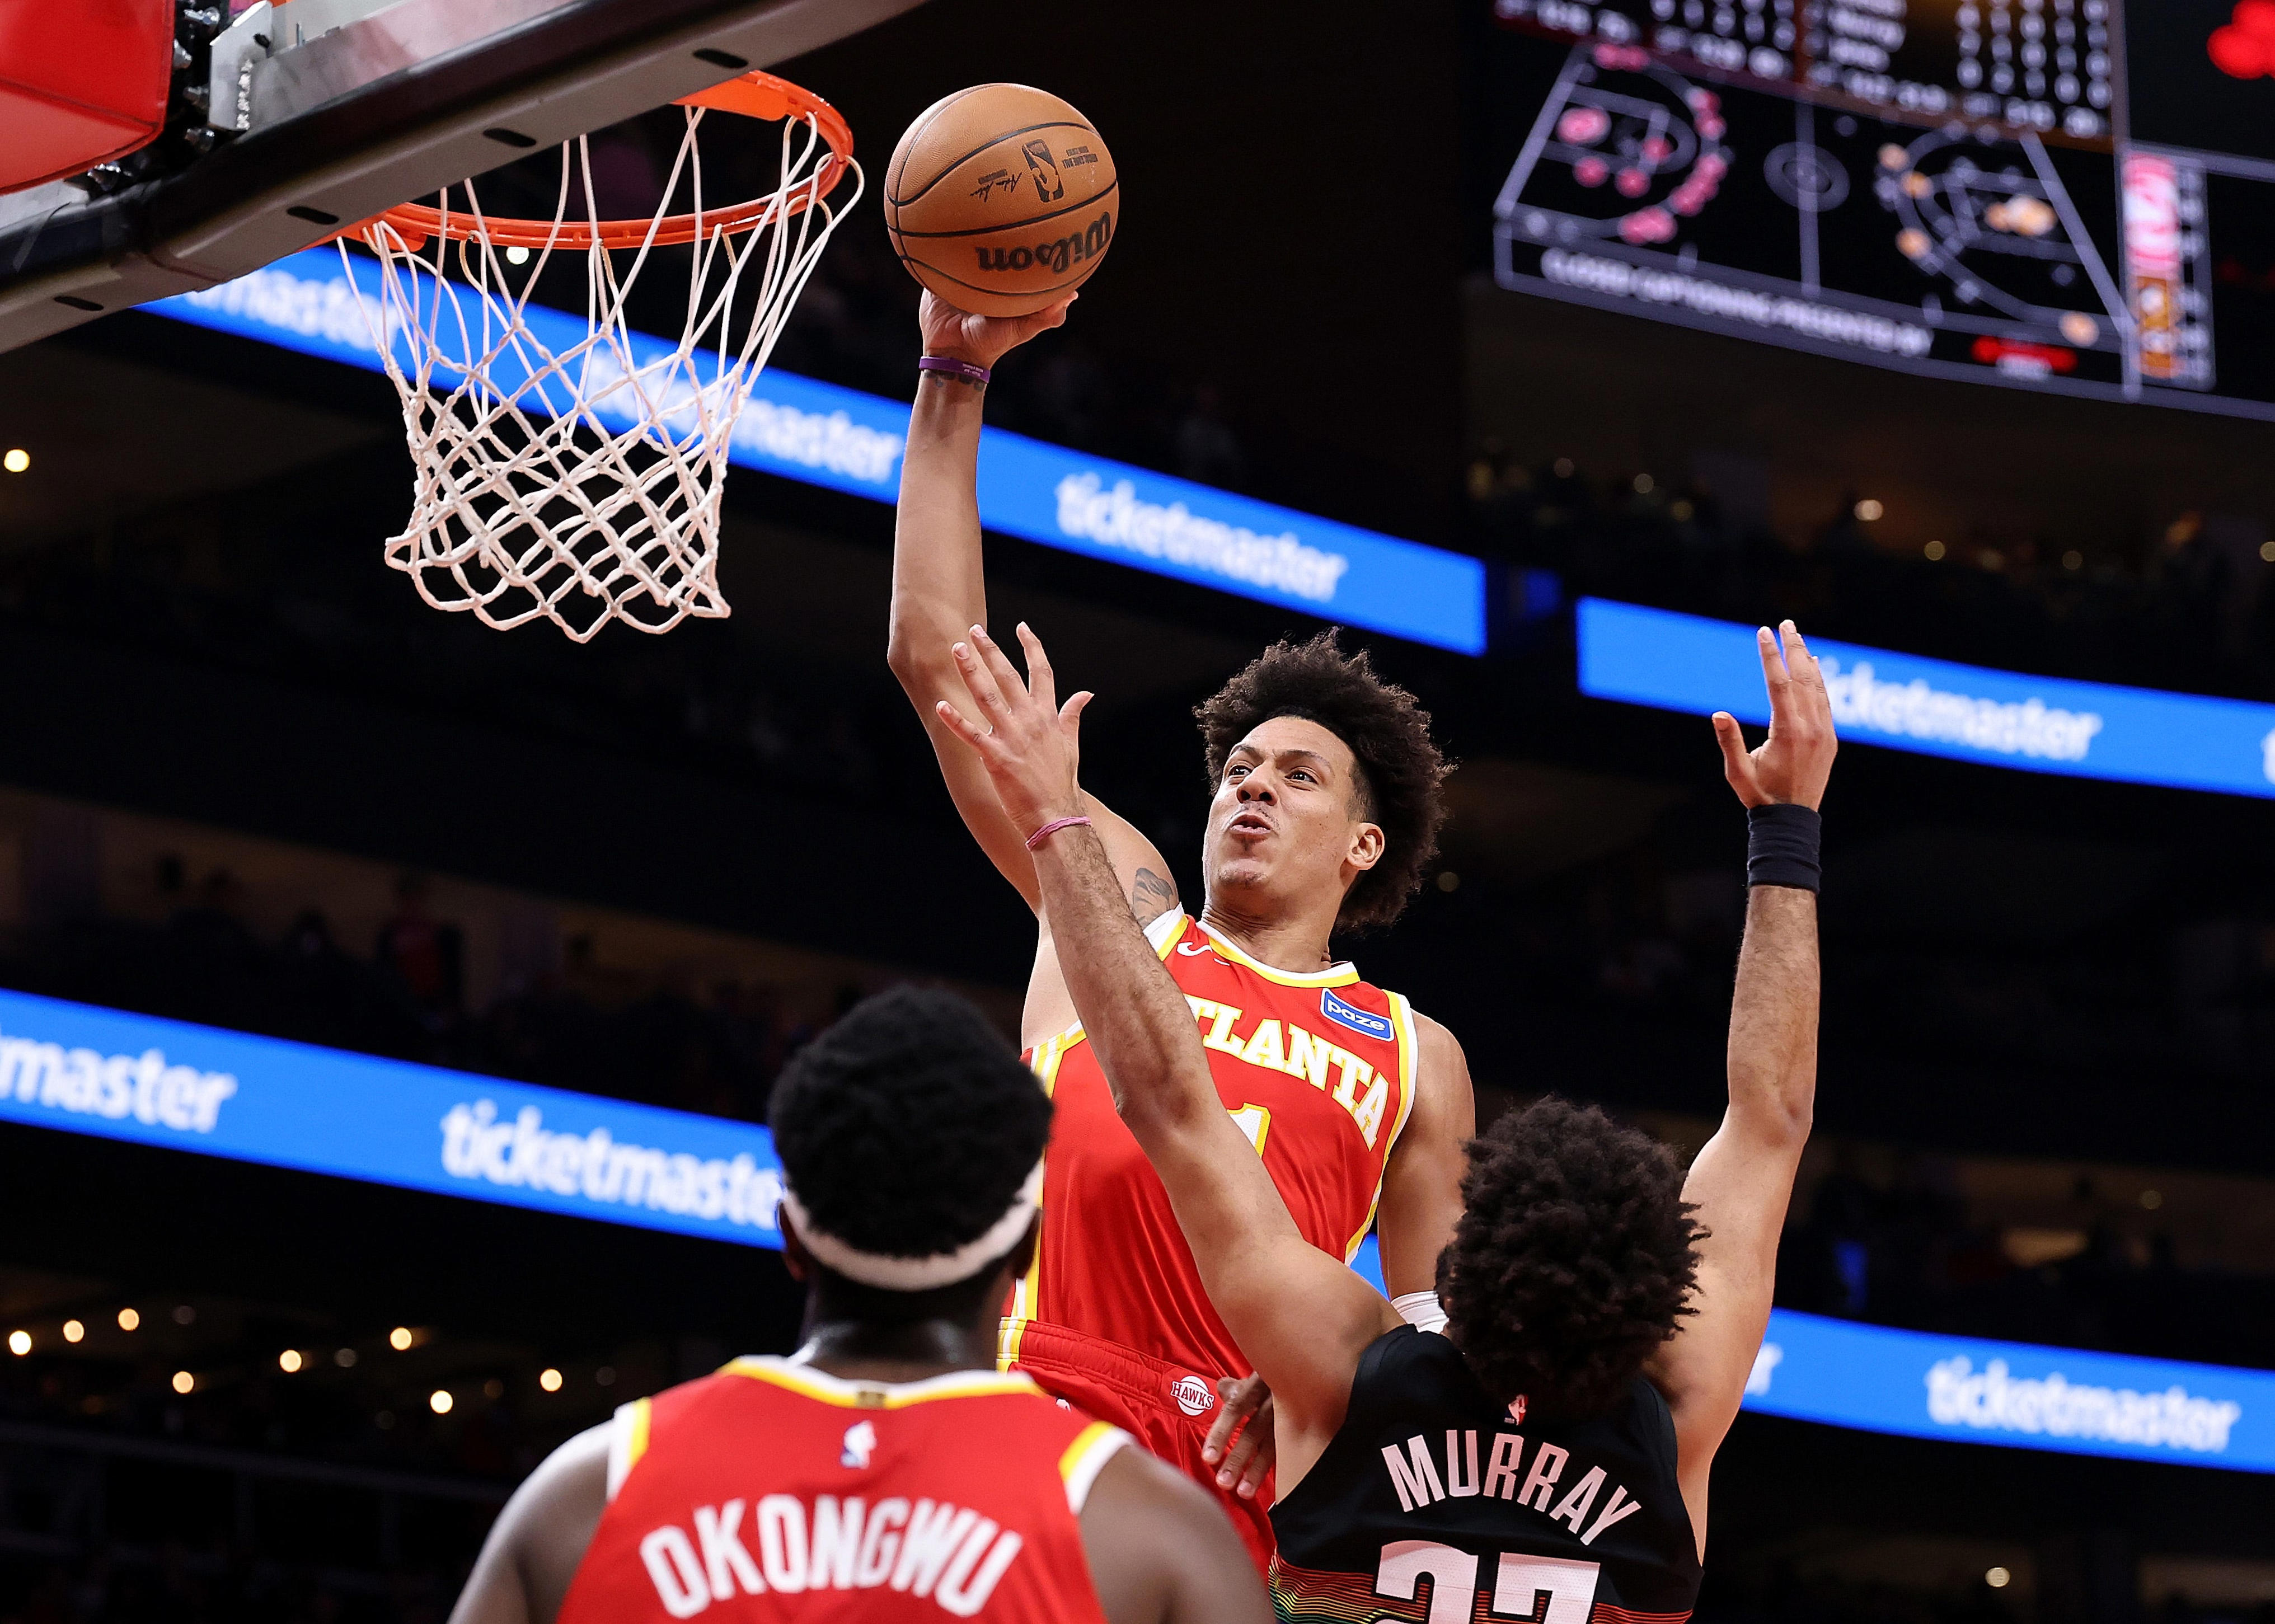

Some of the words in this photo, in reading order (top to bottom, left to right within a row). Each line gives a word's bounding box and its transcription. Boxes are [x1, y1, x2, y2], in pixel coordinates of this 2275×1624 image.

[975, 211, 1111, 275] Wilson
[1054, 471, 1349, 603] ticketmaster
[1822, 656, 2104, 761] icketmaster
[1327, 998, 1386, 1031] paze
[0, 1035, 239, 1135] master
[1182, 993, 1390, 1152] TLANTA
[440, 1098, 784, 1231] ticketmaste
[1171, 1382, 1213, 1409] HAWKS
[1924, 1354, 2240, 1453] ticketmaster
[1381, 1429, 1641, 1546] MURRAY
[639, 1492, 1024, 1620] OKONGWU
[1375, 1539, 1601, 1624] 27
